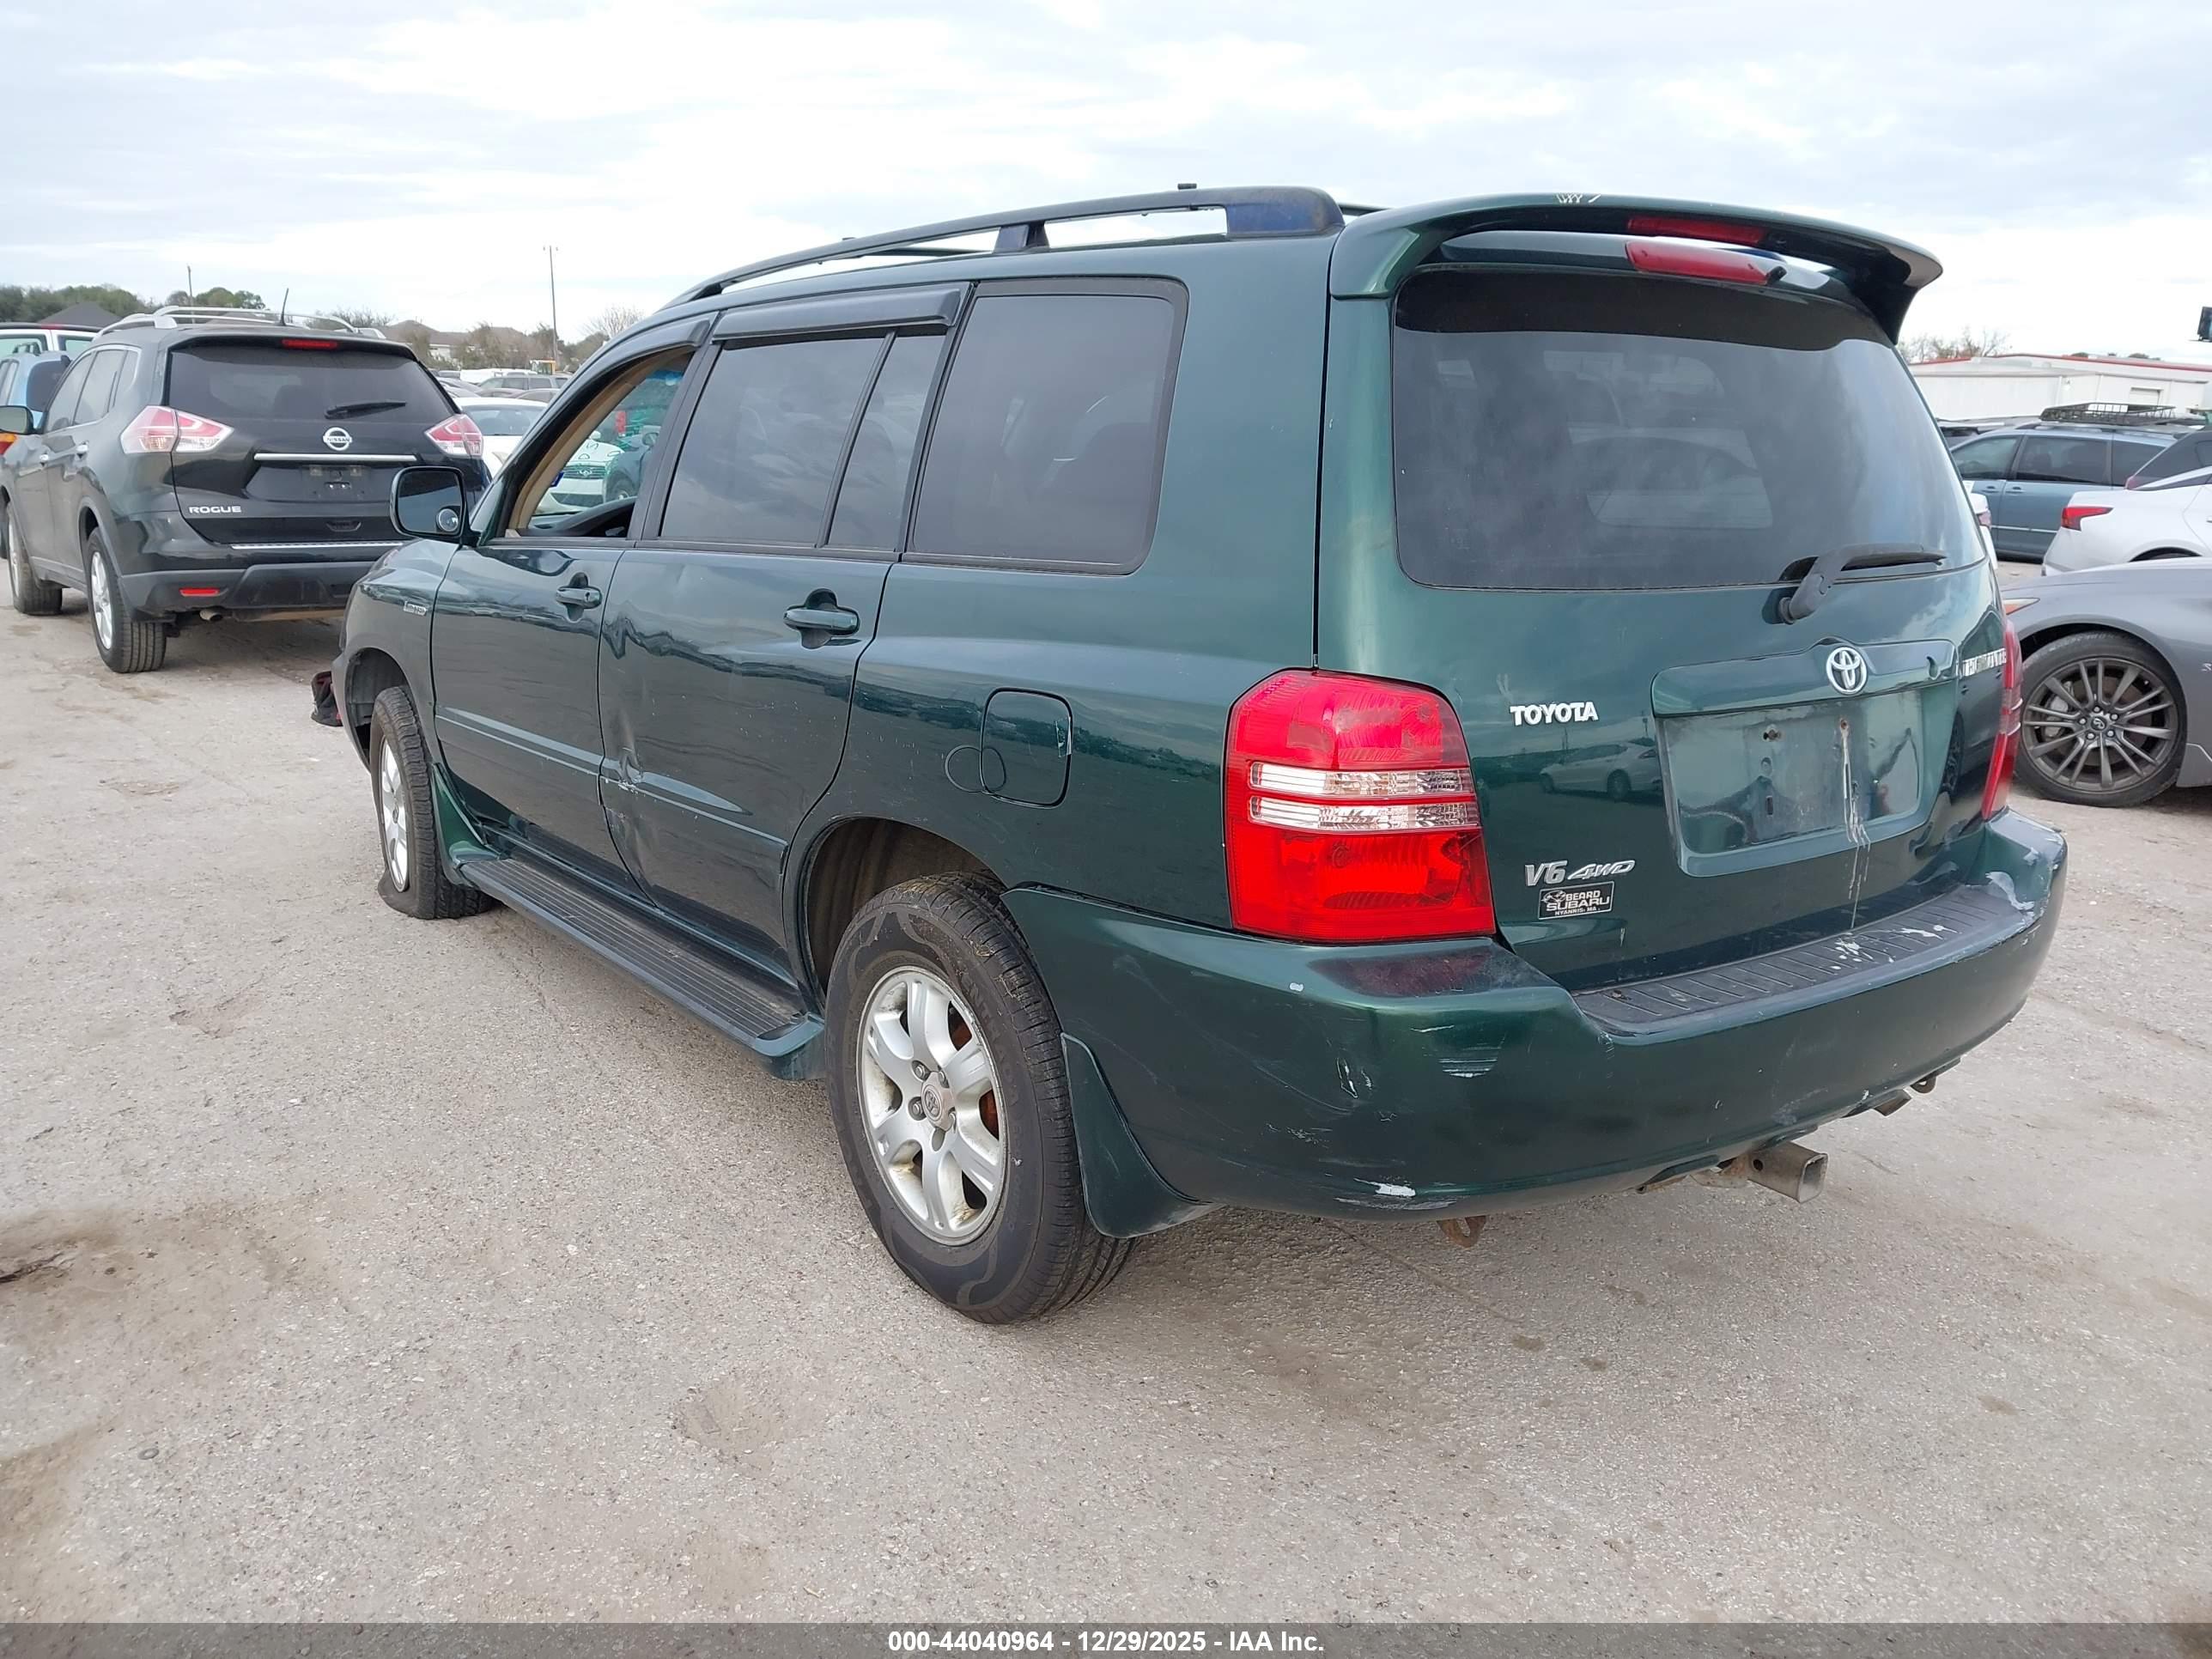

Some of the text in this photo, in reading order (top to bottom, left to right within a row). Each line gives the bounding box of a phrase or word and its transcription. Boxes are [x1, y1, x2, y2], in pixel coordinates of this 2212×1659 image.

[188, 505, 243, 514] ROGUE
[1510, 701, 1599, 726] TOYOTA
[1524, 860, 1636, 887] V6 4WD
[1546, 896, 1611, 911] SUBARU
[1565, 890, 1601, 902] BEARD
